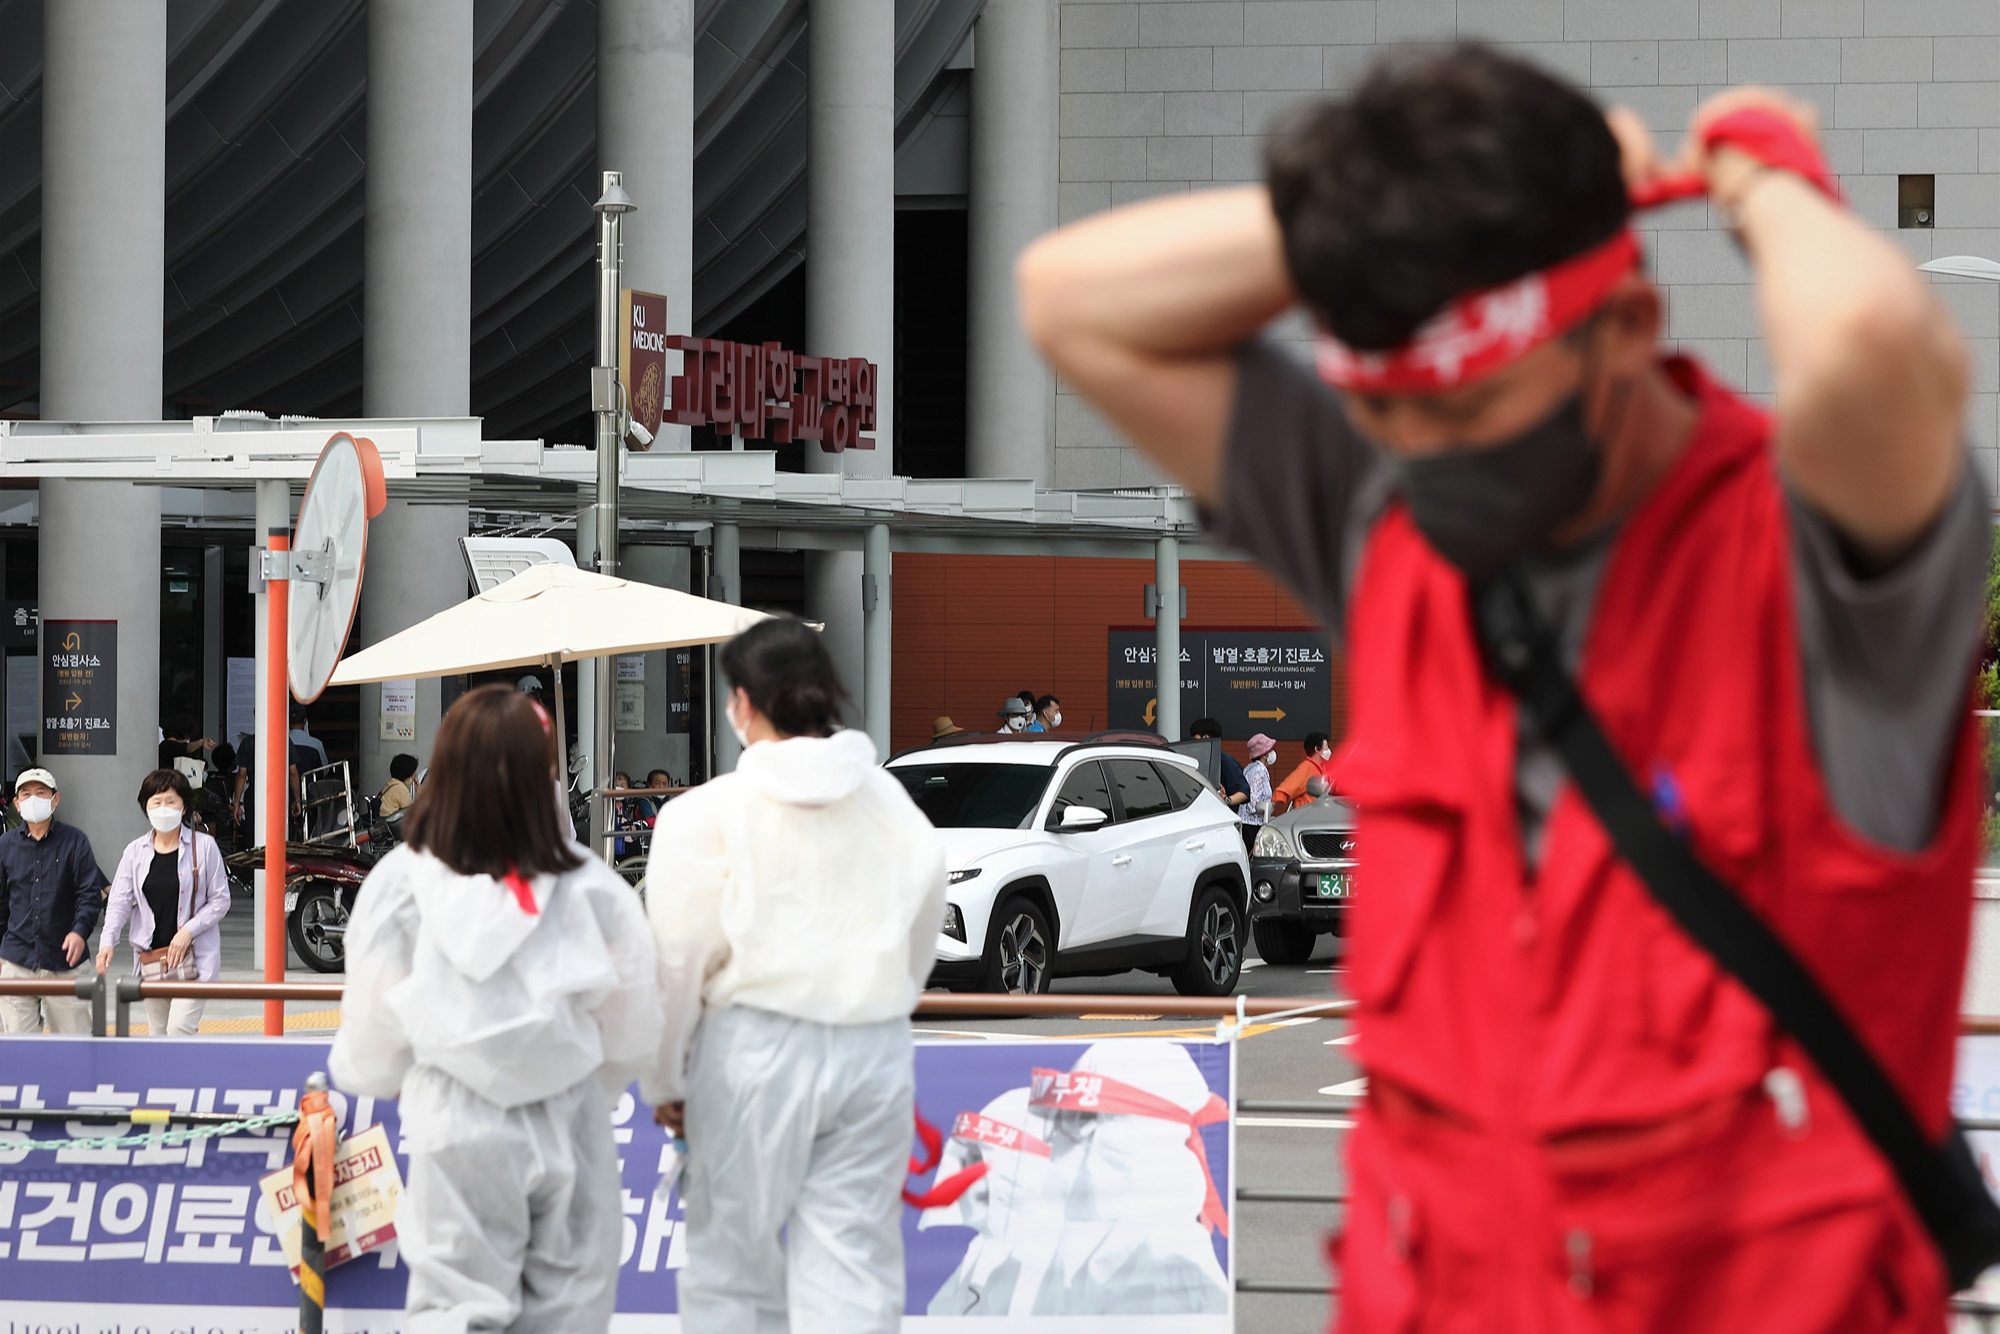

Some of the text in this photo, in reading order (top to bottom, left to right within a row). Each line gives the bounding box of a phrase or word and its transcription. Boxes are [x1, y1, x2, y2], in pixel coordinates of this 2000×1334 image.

[632, 304, 646, 328] KU
[632, 329, 664, 353] MEDICINE
[663, 334, 877, 453] 고려대학교병원
[52, 654, 101, 667] 안심검사소
[1124, 646, 1191, 664] 안심소
[1285, 647, 1325, 664] 진료소
[1293, 680, 1306, 689] 검사
[84, 717, 110, 729] 진료소
[1052, 1073, 1103, 1107] 투쟁
[973, 1116, 1019, 1147] 투쟁
